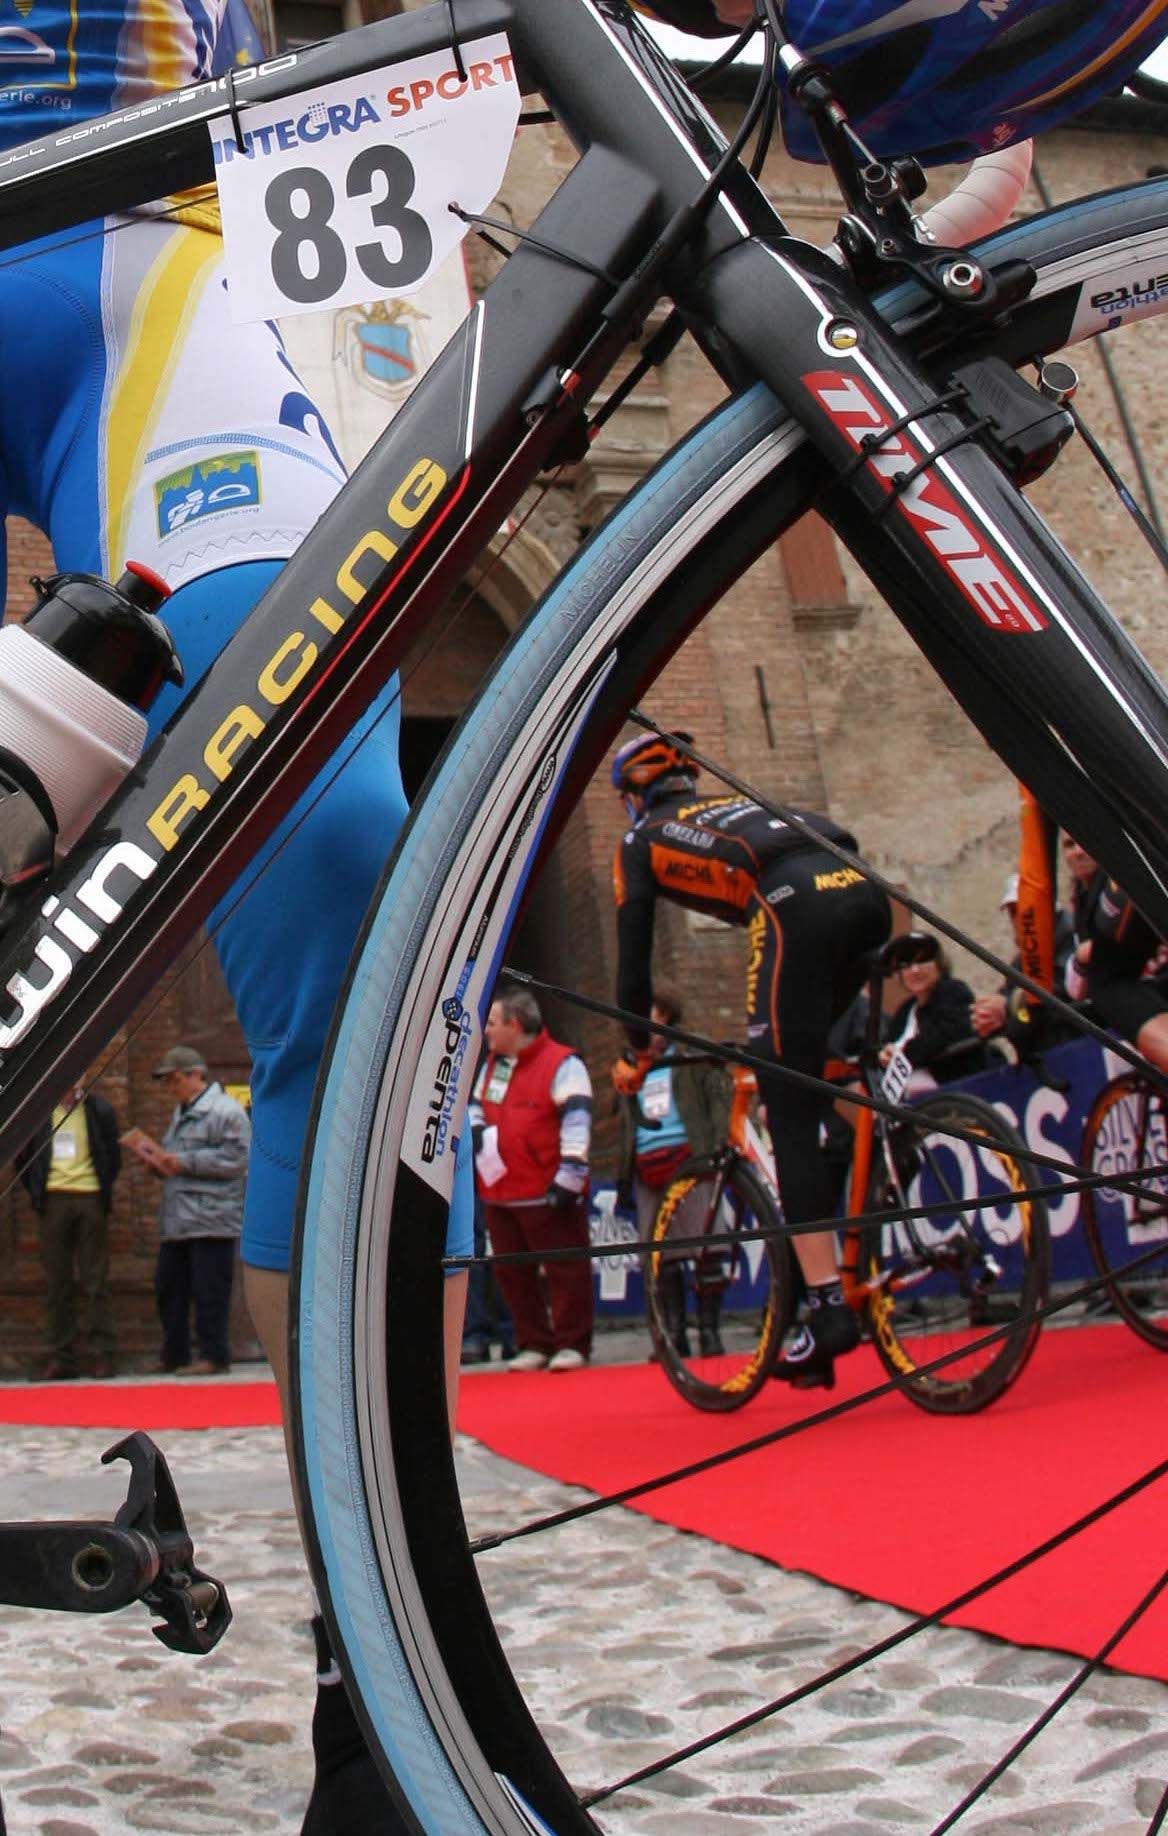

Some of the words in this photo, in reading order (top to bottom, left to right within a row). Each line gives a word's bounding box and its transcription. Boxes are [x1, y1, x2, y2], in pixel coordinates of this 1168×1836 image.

[213, 96, 382, 166] INTEGRA
[386, 53, 514, 118] SPORT
[264, 143, 434, 304] 83
[816, 377, 1043, 632] TIME
[145, 457, 448, 853] RACING
[437, 1010, 472, 1157] decathlon
